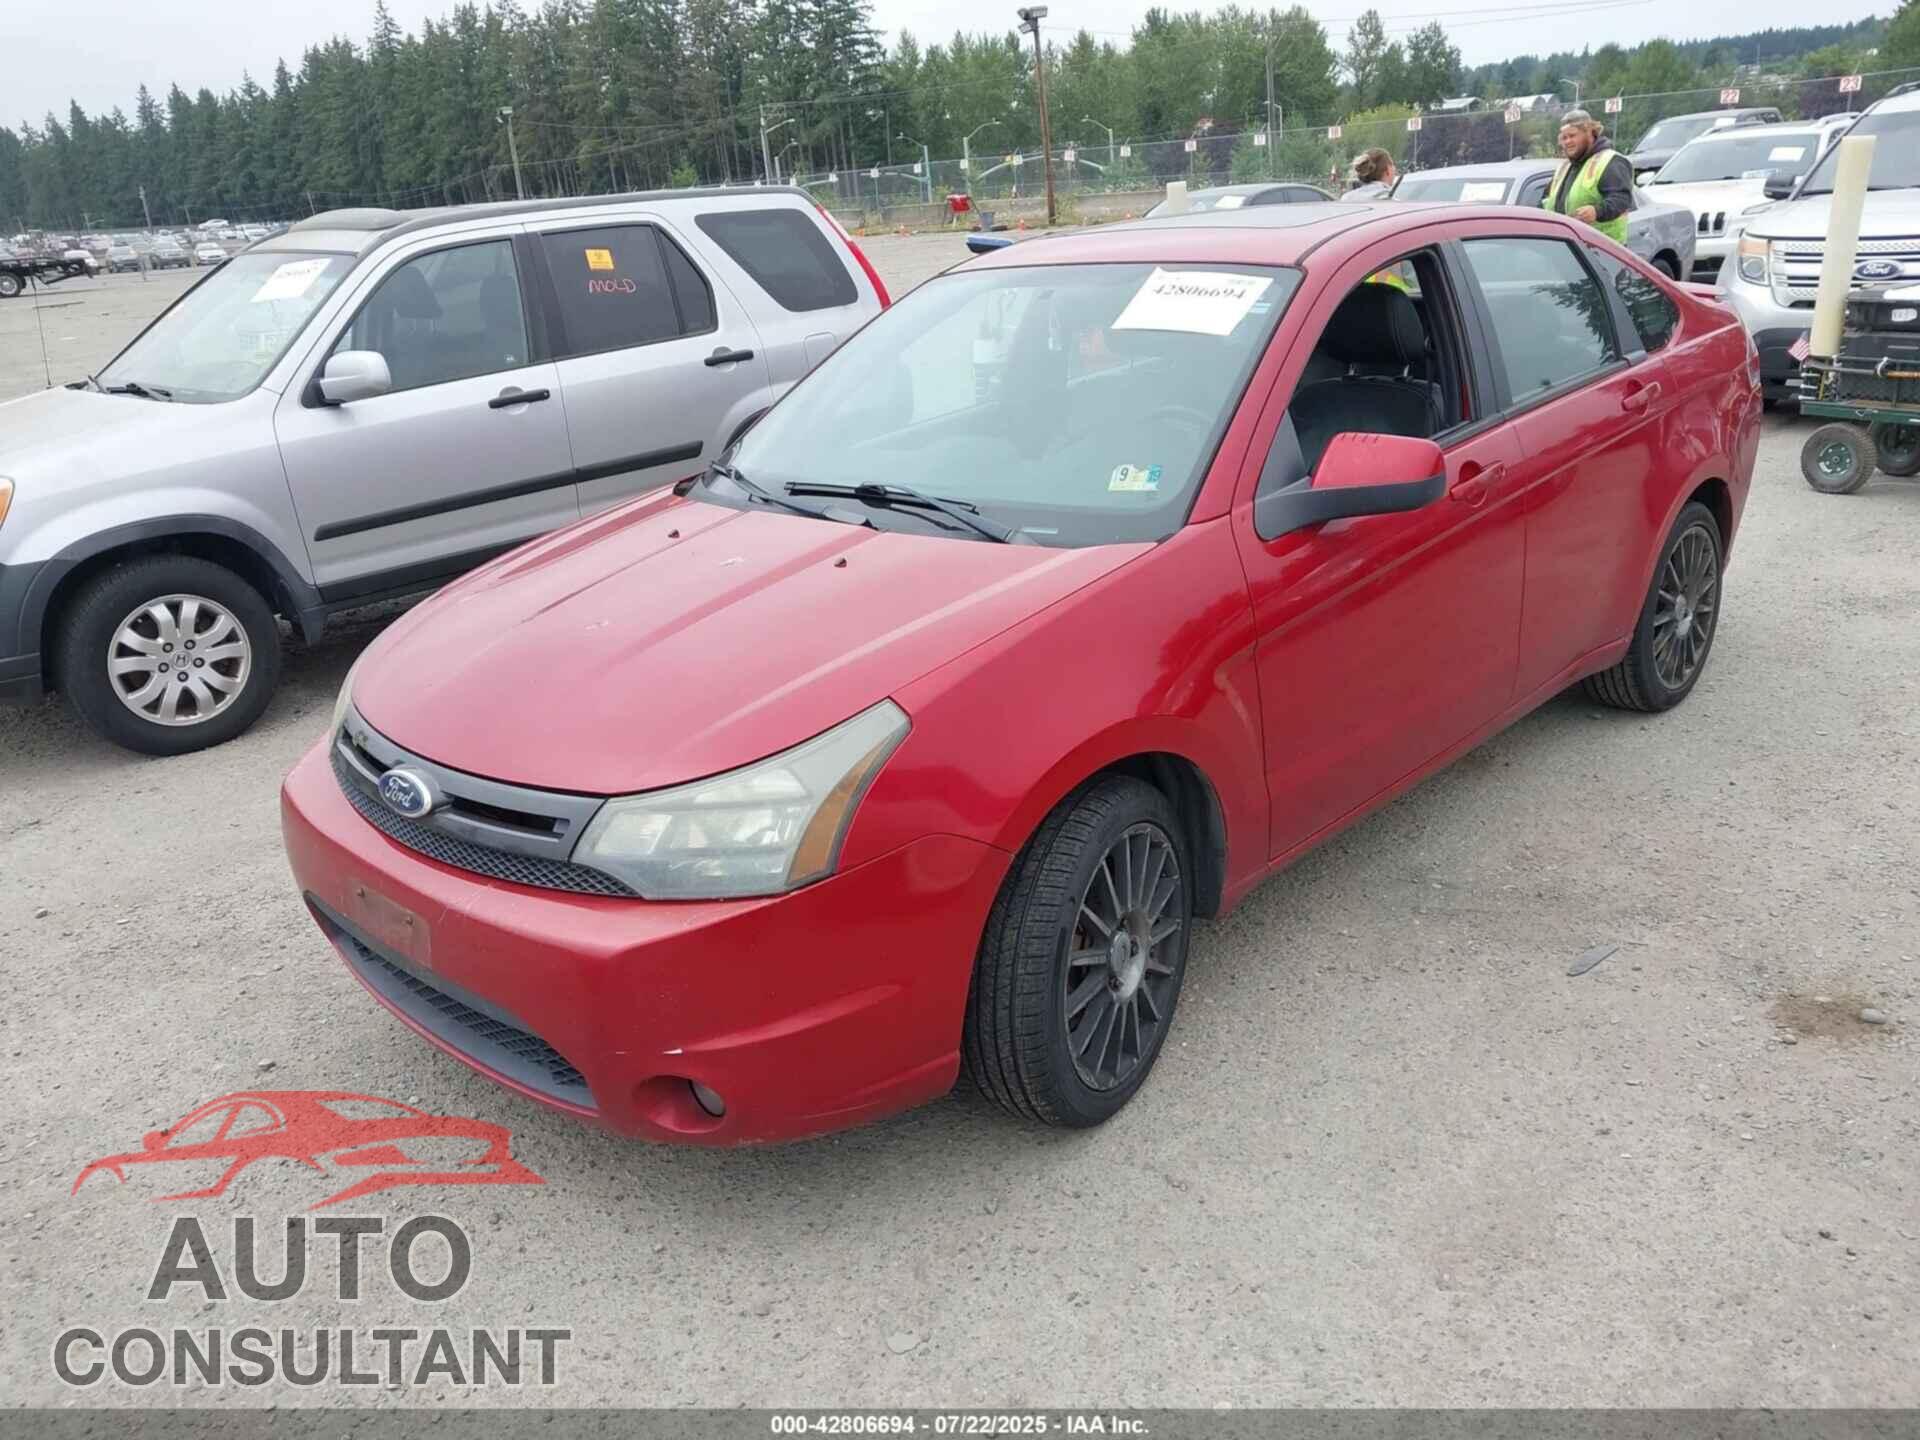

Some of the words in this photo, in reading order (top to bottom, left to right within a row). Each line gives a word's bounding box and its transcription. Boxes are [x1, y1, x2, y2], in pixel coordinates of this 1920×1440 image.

[1722, 89, 1737, 103] 22
[1863, 263, 1891, 275] Ford
[589, 278, 637, 293] MOLD
[1153, 284, 1247, 299] 42806694
[1119, 467, 1129, 481] 9
[384, 776, 415, 808] Ford
